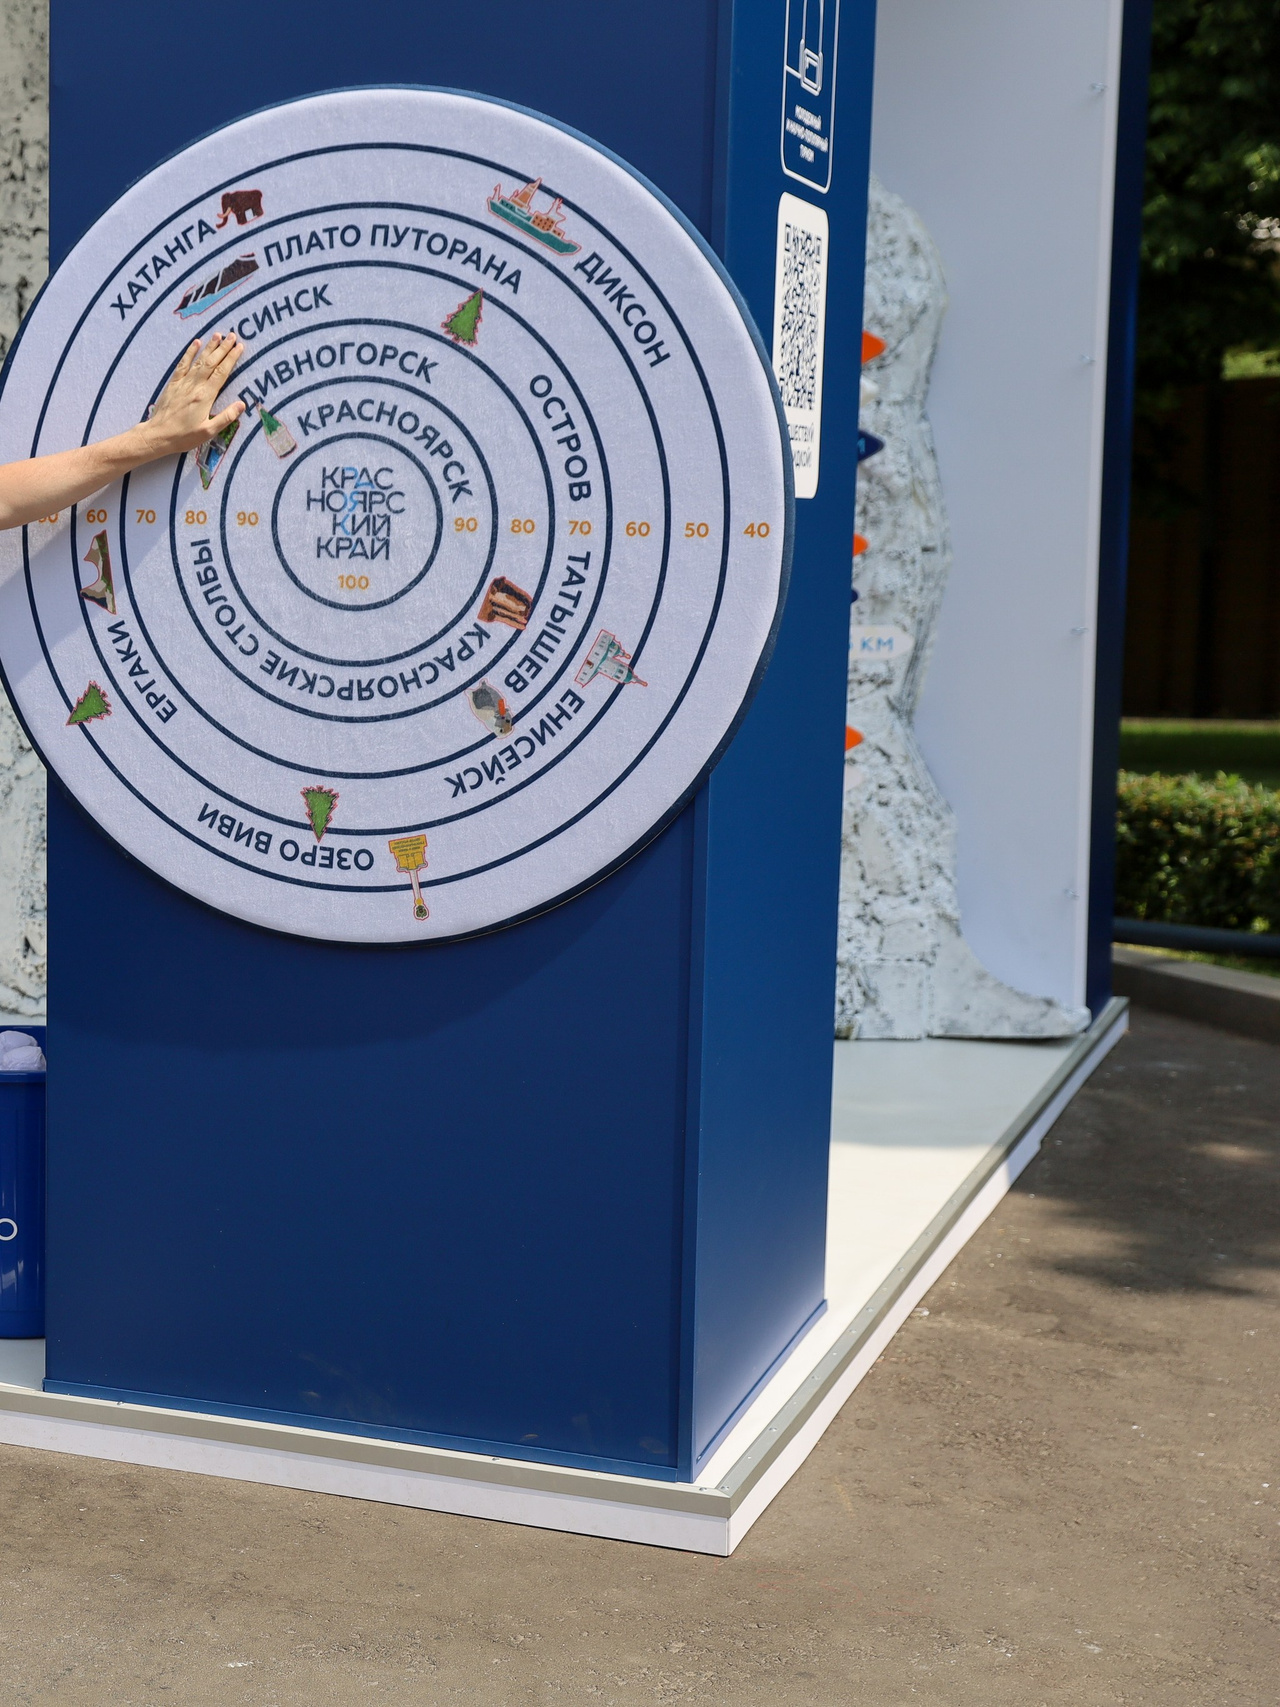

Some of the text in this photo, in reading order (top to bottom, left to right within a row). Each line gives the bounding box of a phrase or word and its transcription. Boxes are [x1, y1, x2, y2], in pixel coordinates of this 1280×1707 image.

[110, 218, 217, 321] ХАТАНГА
[263, 224, 522, 295] ПЛАТО ПУТОРАНА
[222, 283, 333, 347] СИНСК
[573, 251, 671, 368] ДИКСОН
[238, 341, 439, 417] ДИВНОГОРСК
[296, 398, 473, 504] КРАСНОЯРСК
[321, 466, 394, 490] КРАС
[86, 508, 108, 524] 60
[135, 509, 156, 524] 70
[184, 510, 208, 525] 80
[237, 511, 260, 526] 90
[306, 489, 406, 514] НОЯРС
[332, 513, 391, 537] КИЙ
[454, 517, 770, 538] 90 80 70 60 50 40
[503, 374, 592, 694] ОСТРОВ ТАТЫШЕВ
[316, 536, 390, 560] КРАЙ
[337, 575, 370, 590] 100
[190, 538, 492, 702] КРАСНОЯРСКИЕ СТОЛБЫ
[106, 619, 178, 724] ЕРГАКИ
[443, 688, 586, 799] ЕНИСЕЙСК
[197, 802, 375, 872] ОЗЕРО ВИВИ
